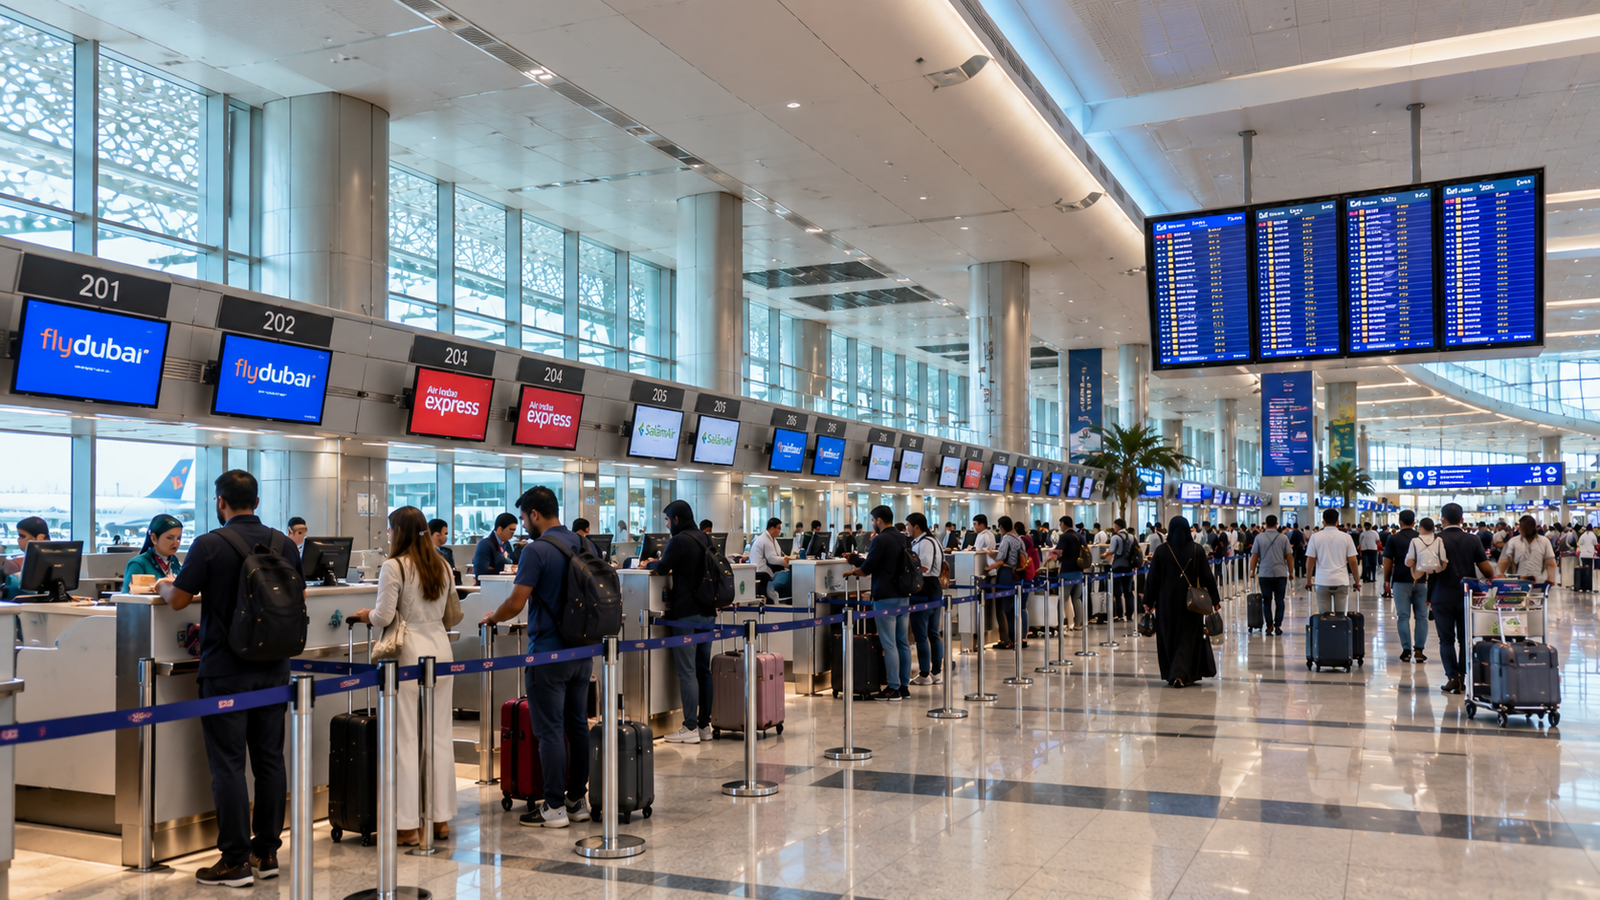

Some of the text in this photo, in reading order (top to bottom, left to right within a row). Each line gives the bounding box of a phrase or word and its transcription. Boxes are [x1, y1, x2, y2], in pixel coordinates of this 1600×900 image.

[79, 274, 120, 302] 201
[263, 311, 295, 335] 202
[40, 328, 147, 364] flydubai
[444, 347, 468, 367] 204
[234, 358, 314, 388] flydubai
[544, 367, 563, 384] 204
[427, 385, 438, 394] Air
[652, 388, 667, 402] 205
[425, 395, 480, 416] express
[713, 400, 727, 413] 205
[527, 410, 571, 429] express
